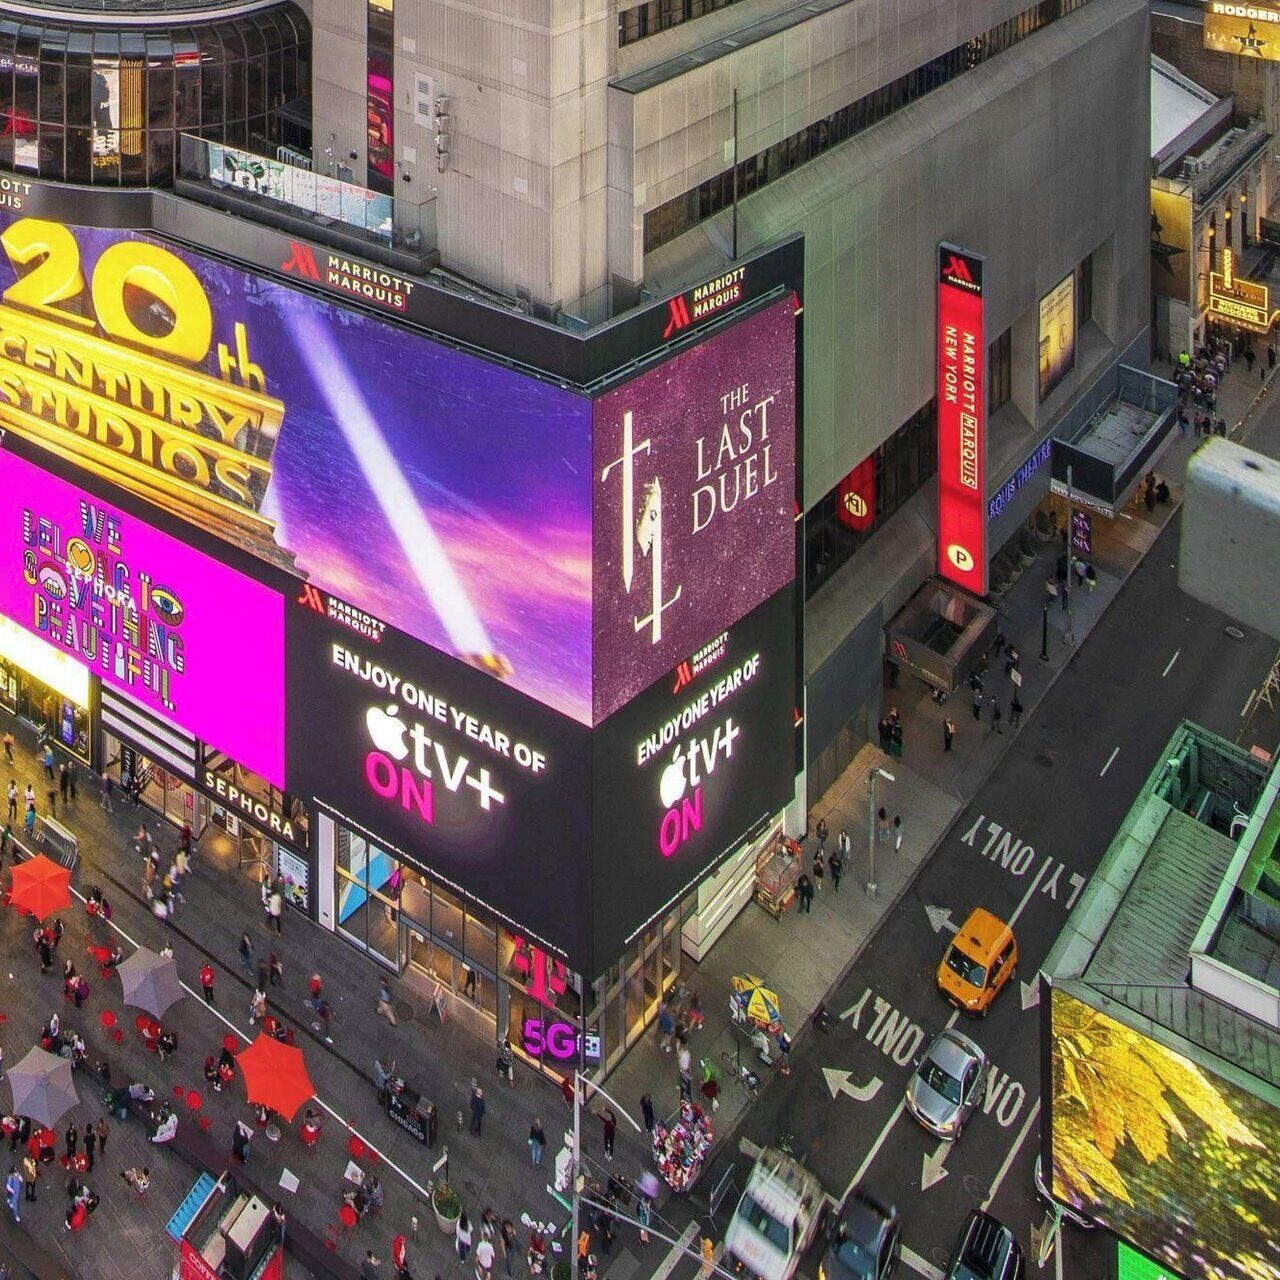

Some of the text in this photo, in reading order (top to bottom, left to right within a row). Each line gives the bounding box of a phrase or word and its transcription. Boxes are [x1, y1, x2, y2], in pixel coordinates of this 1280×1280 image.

[1213, 2, 1280, 22] RODGER
[328, 255, 414, 294] MARRIOTT
[328, 270, 404, 308] MARQUIS
[694, 267, 745, 301] MARRIOTT
[949, 275, 981, 291] MARRIOTT
[694, 285, 740, 318] MARQUIS
[945, 326, 958, 402] NEW YORK
[720, 383, 749, 414] THE
[962, 332, 976, 487] MARRIOTT MARQUIS
[696, 395, 775, 482] LAST
[691, 444, 777, 535] DUEL
[80, 500, 122, 555] WE
[65, 561, 137, 613] SEPHORA
[329, 597, 386, 632] MARRIOTT
[329, 608, 379, 641] MARQUIS
[693, 631, 729, 663] MARRIOTT
[693, 645, 725, 675] MARQUIS
[332, 643, 546, 774] ENJOY ONE YEAR OF
[638, 653, 760, 766] ENJOY ONE YEAR OF
[206, 771, 295, 840] SEPHORA
[365, 751, 434, 825] ON
[659, 786, 702, 857] ON
[960, 814, 1035, 875] ONLY
[524, 1019, 576, 1060] 5G
[839, 988, 925, 1067] ONLY
